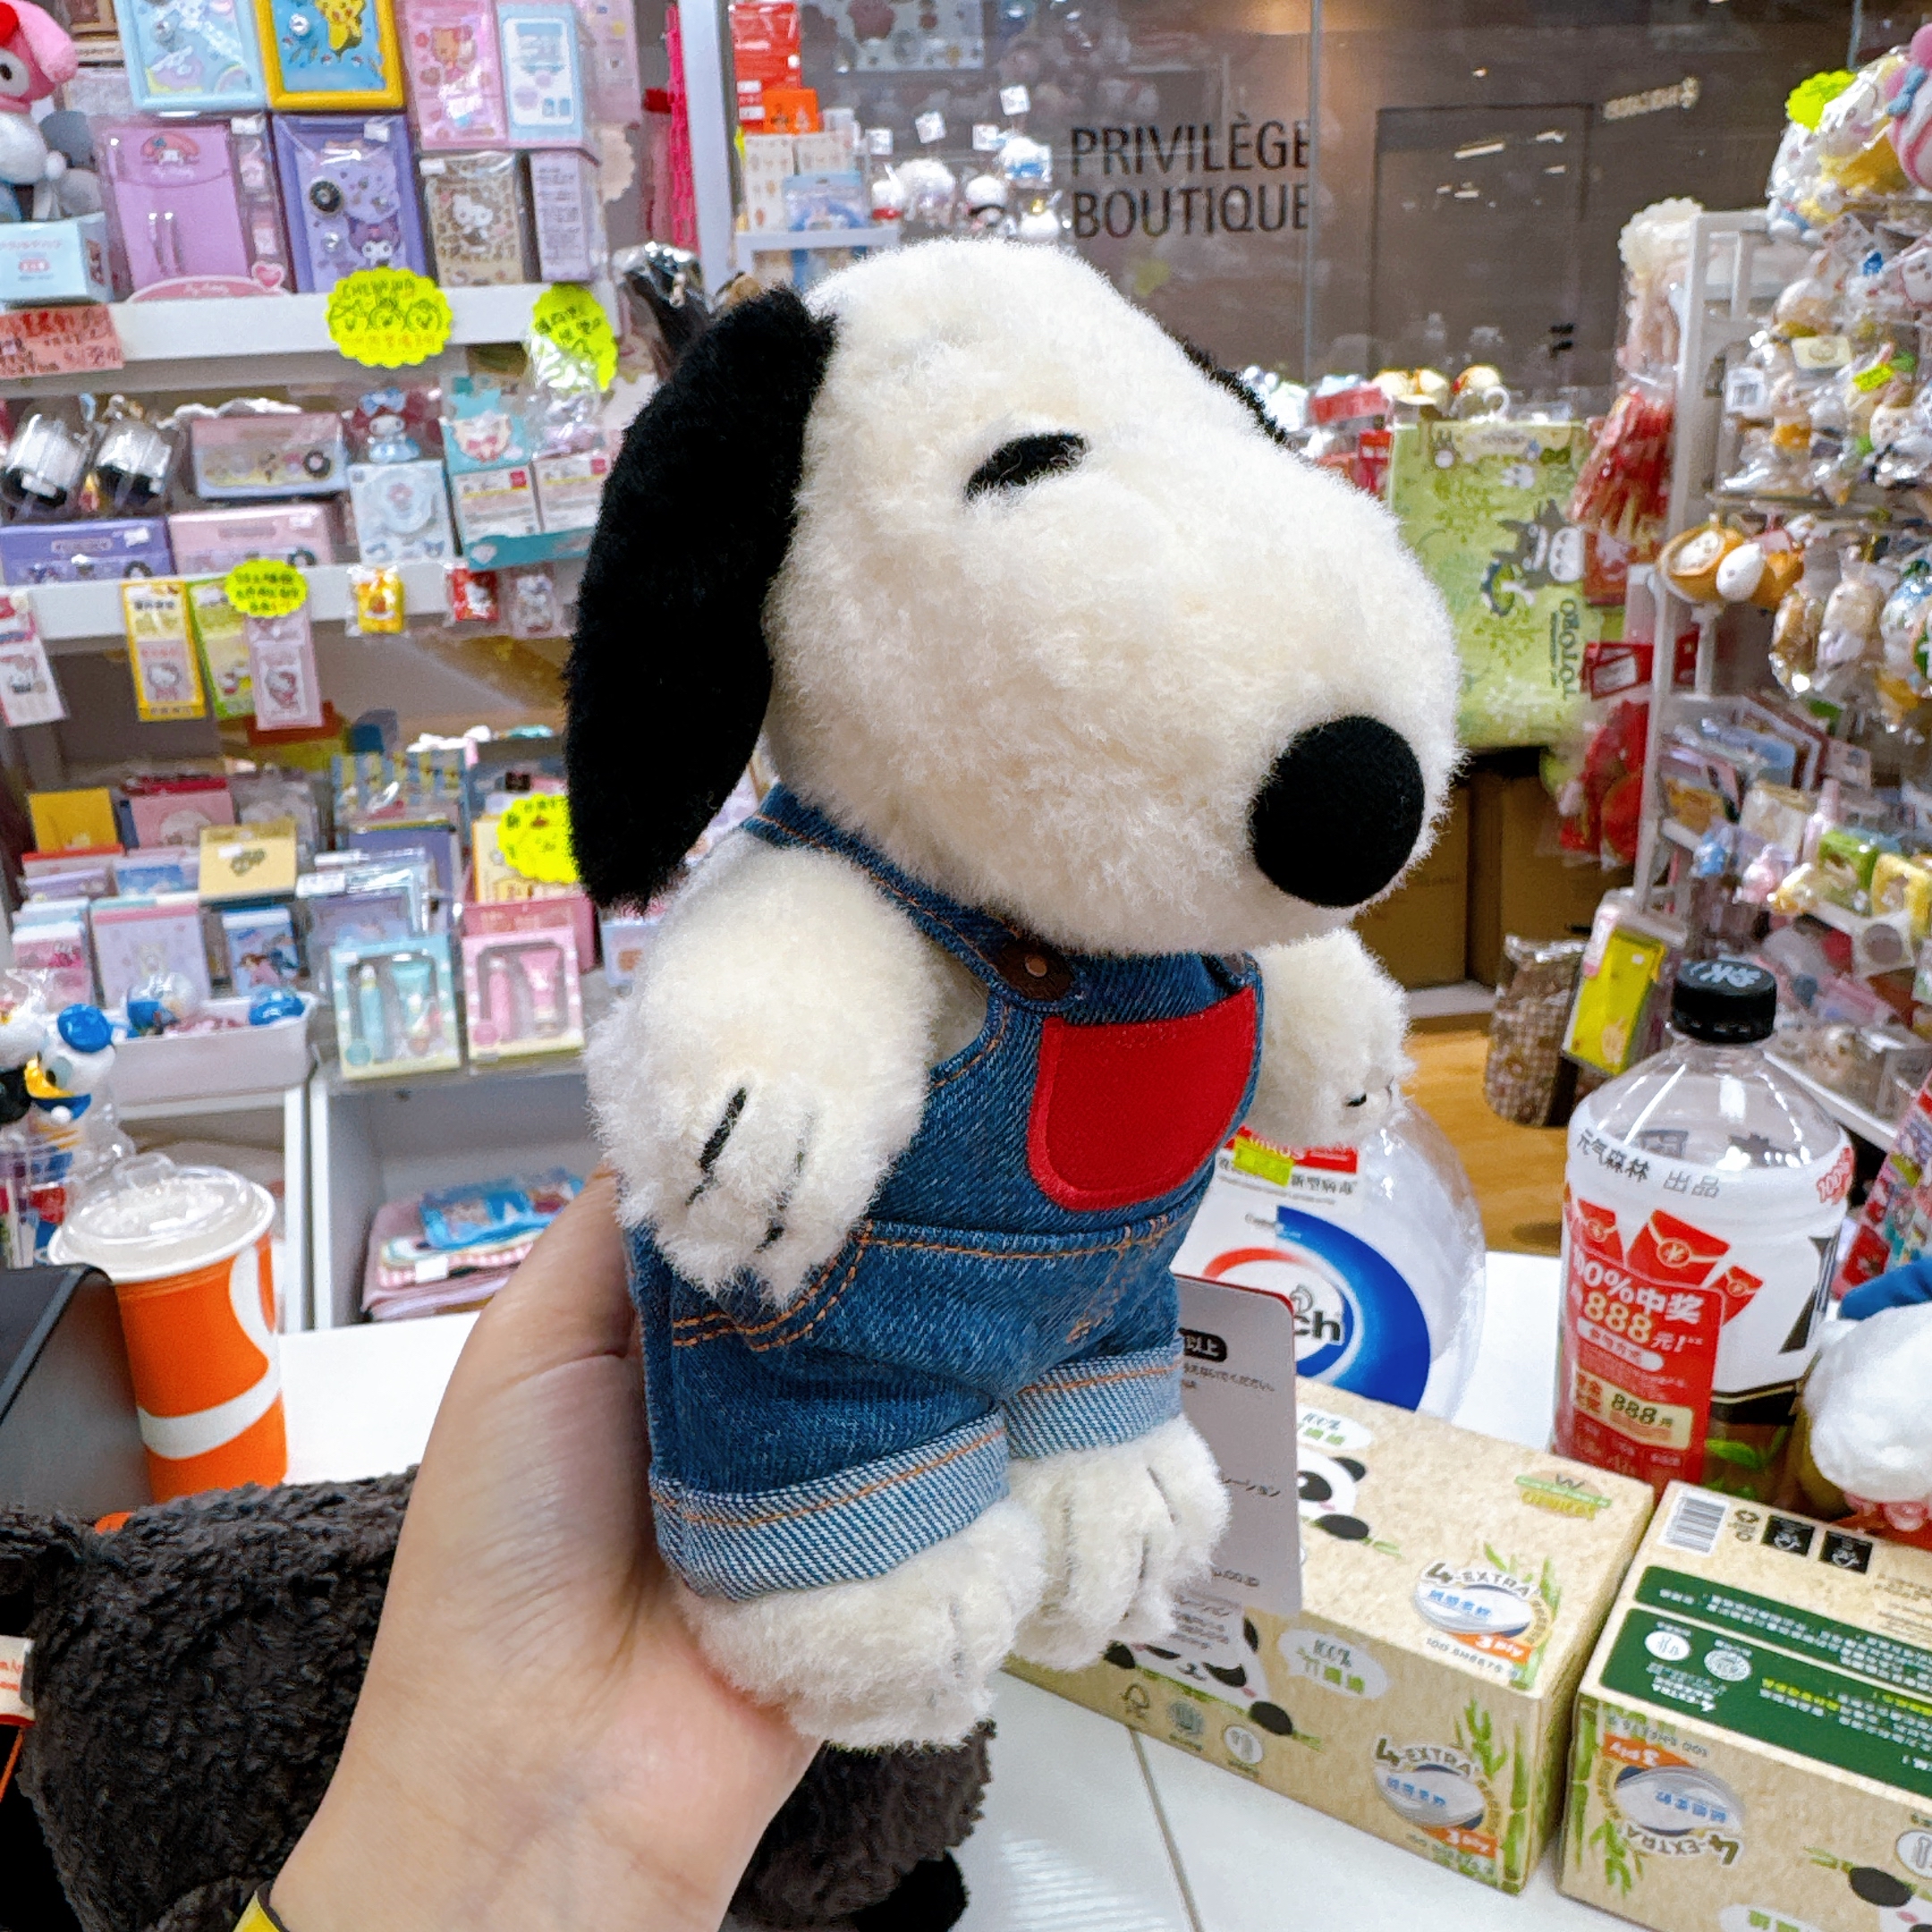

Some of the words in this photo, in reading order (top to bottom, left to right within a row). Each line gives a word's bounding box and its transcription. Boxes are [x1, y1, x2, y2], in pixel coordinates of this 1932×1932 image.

[1071, 111, 1309, 175] PRIVILÈGE
[1073, 183, 1309, 239] BOUTIQUE
[1577, 1129, 1649, 1183] 元气森林
